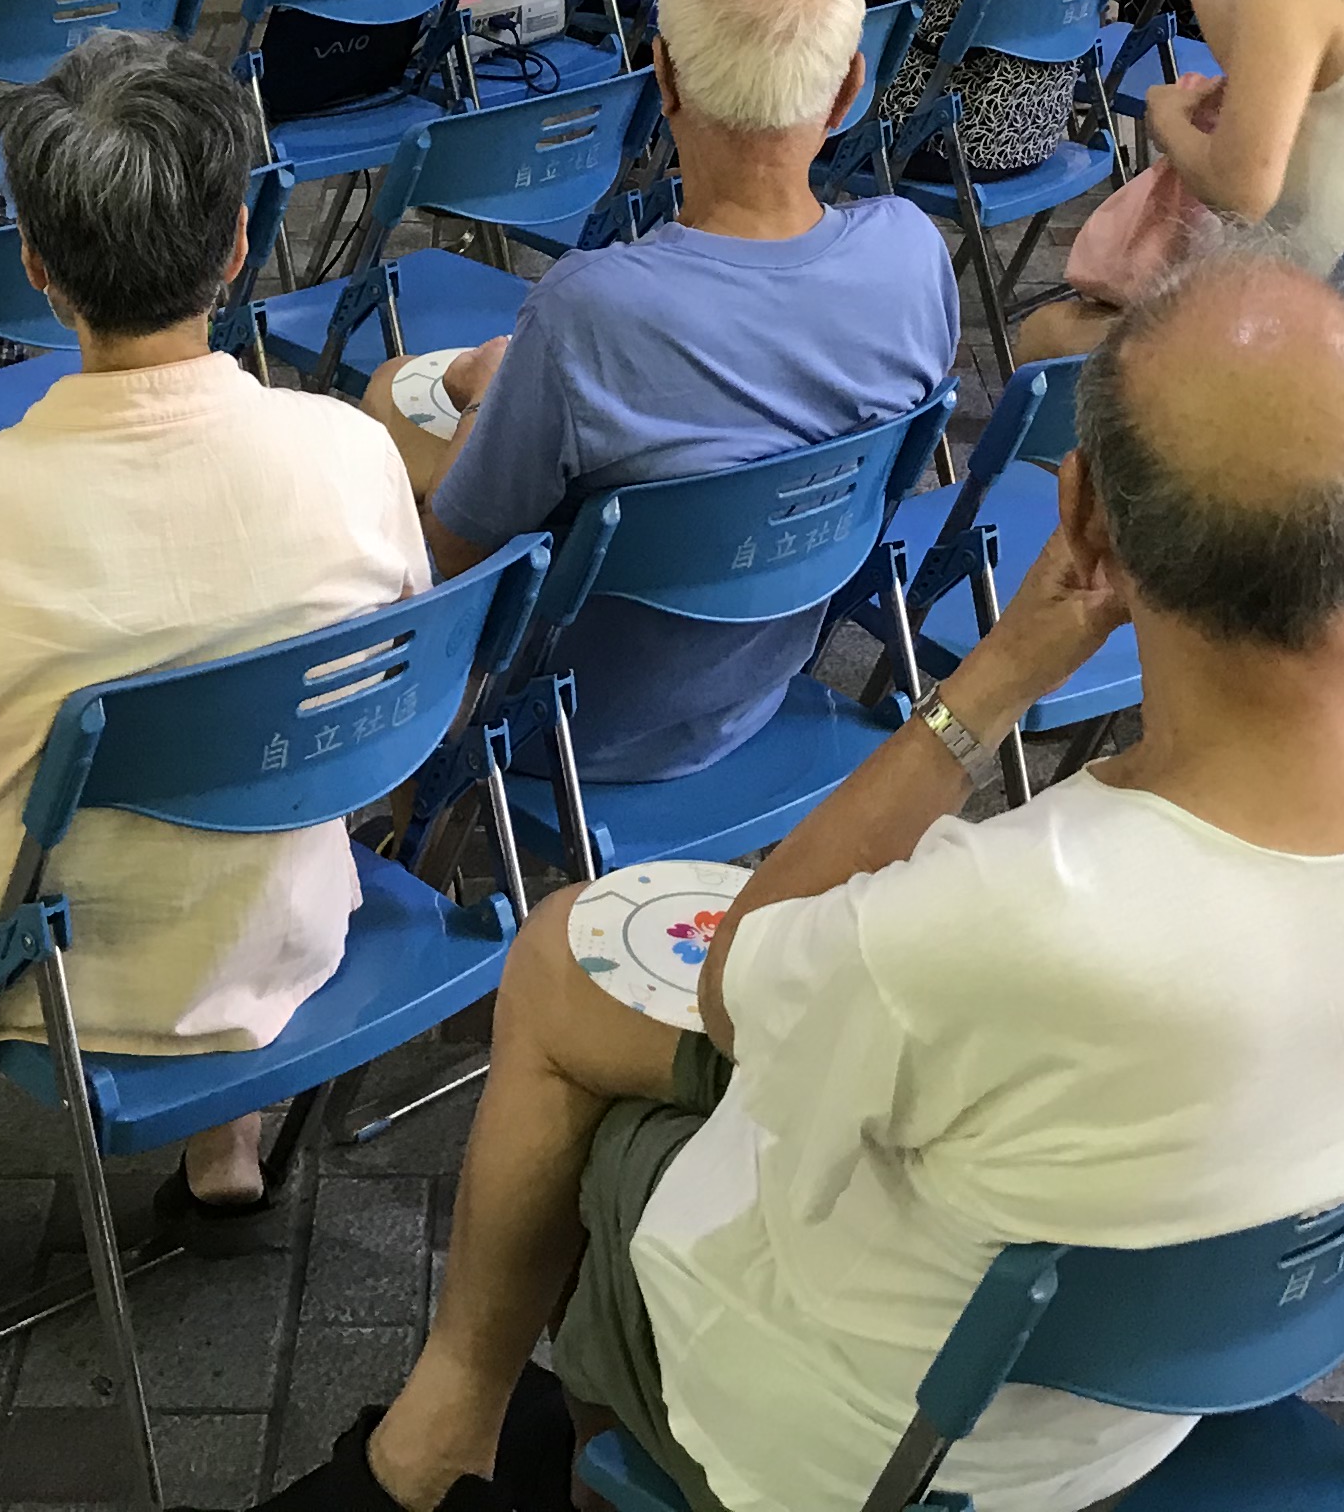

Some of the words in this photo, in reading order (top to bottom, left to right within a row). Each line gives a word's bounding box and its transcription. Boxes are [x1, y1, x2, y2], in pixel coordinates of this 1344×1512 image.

[314, 35, 370, 59] VAIO
[730, 512, 854, 570] 自立社區
[261, 682, 420, 772] 自立社區
